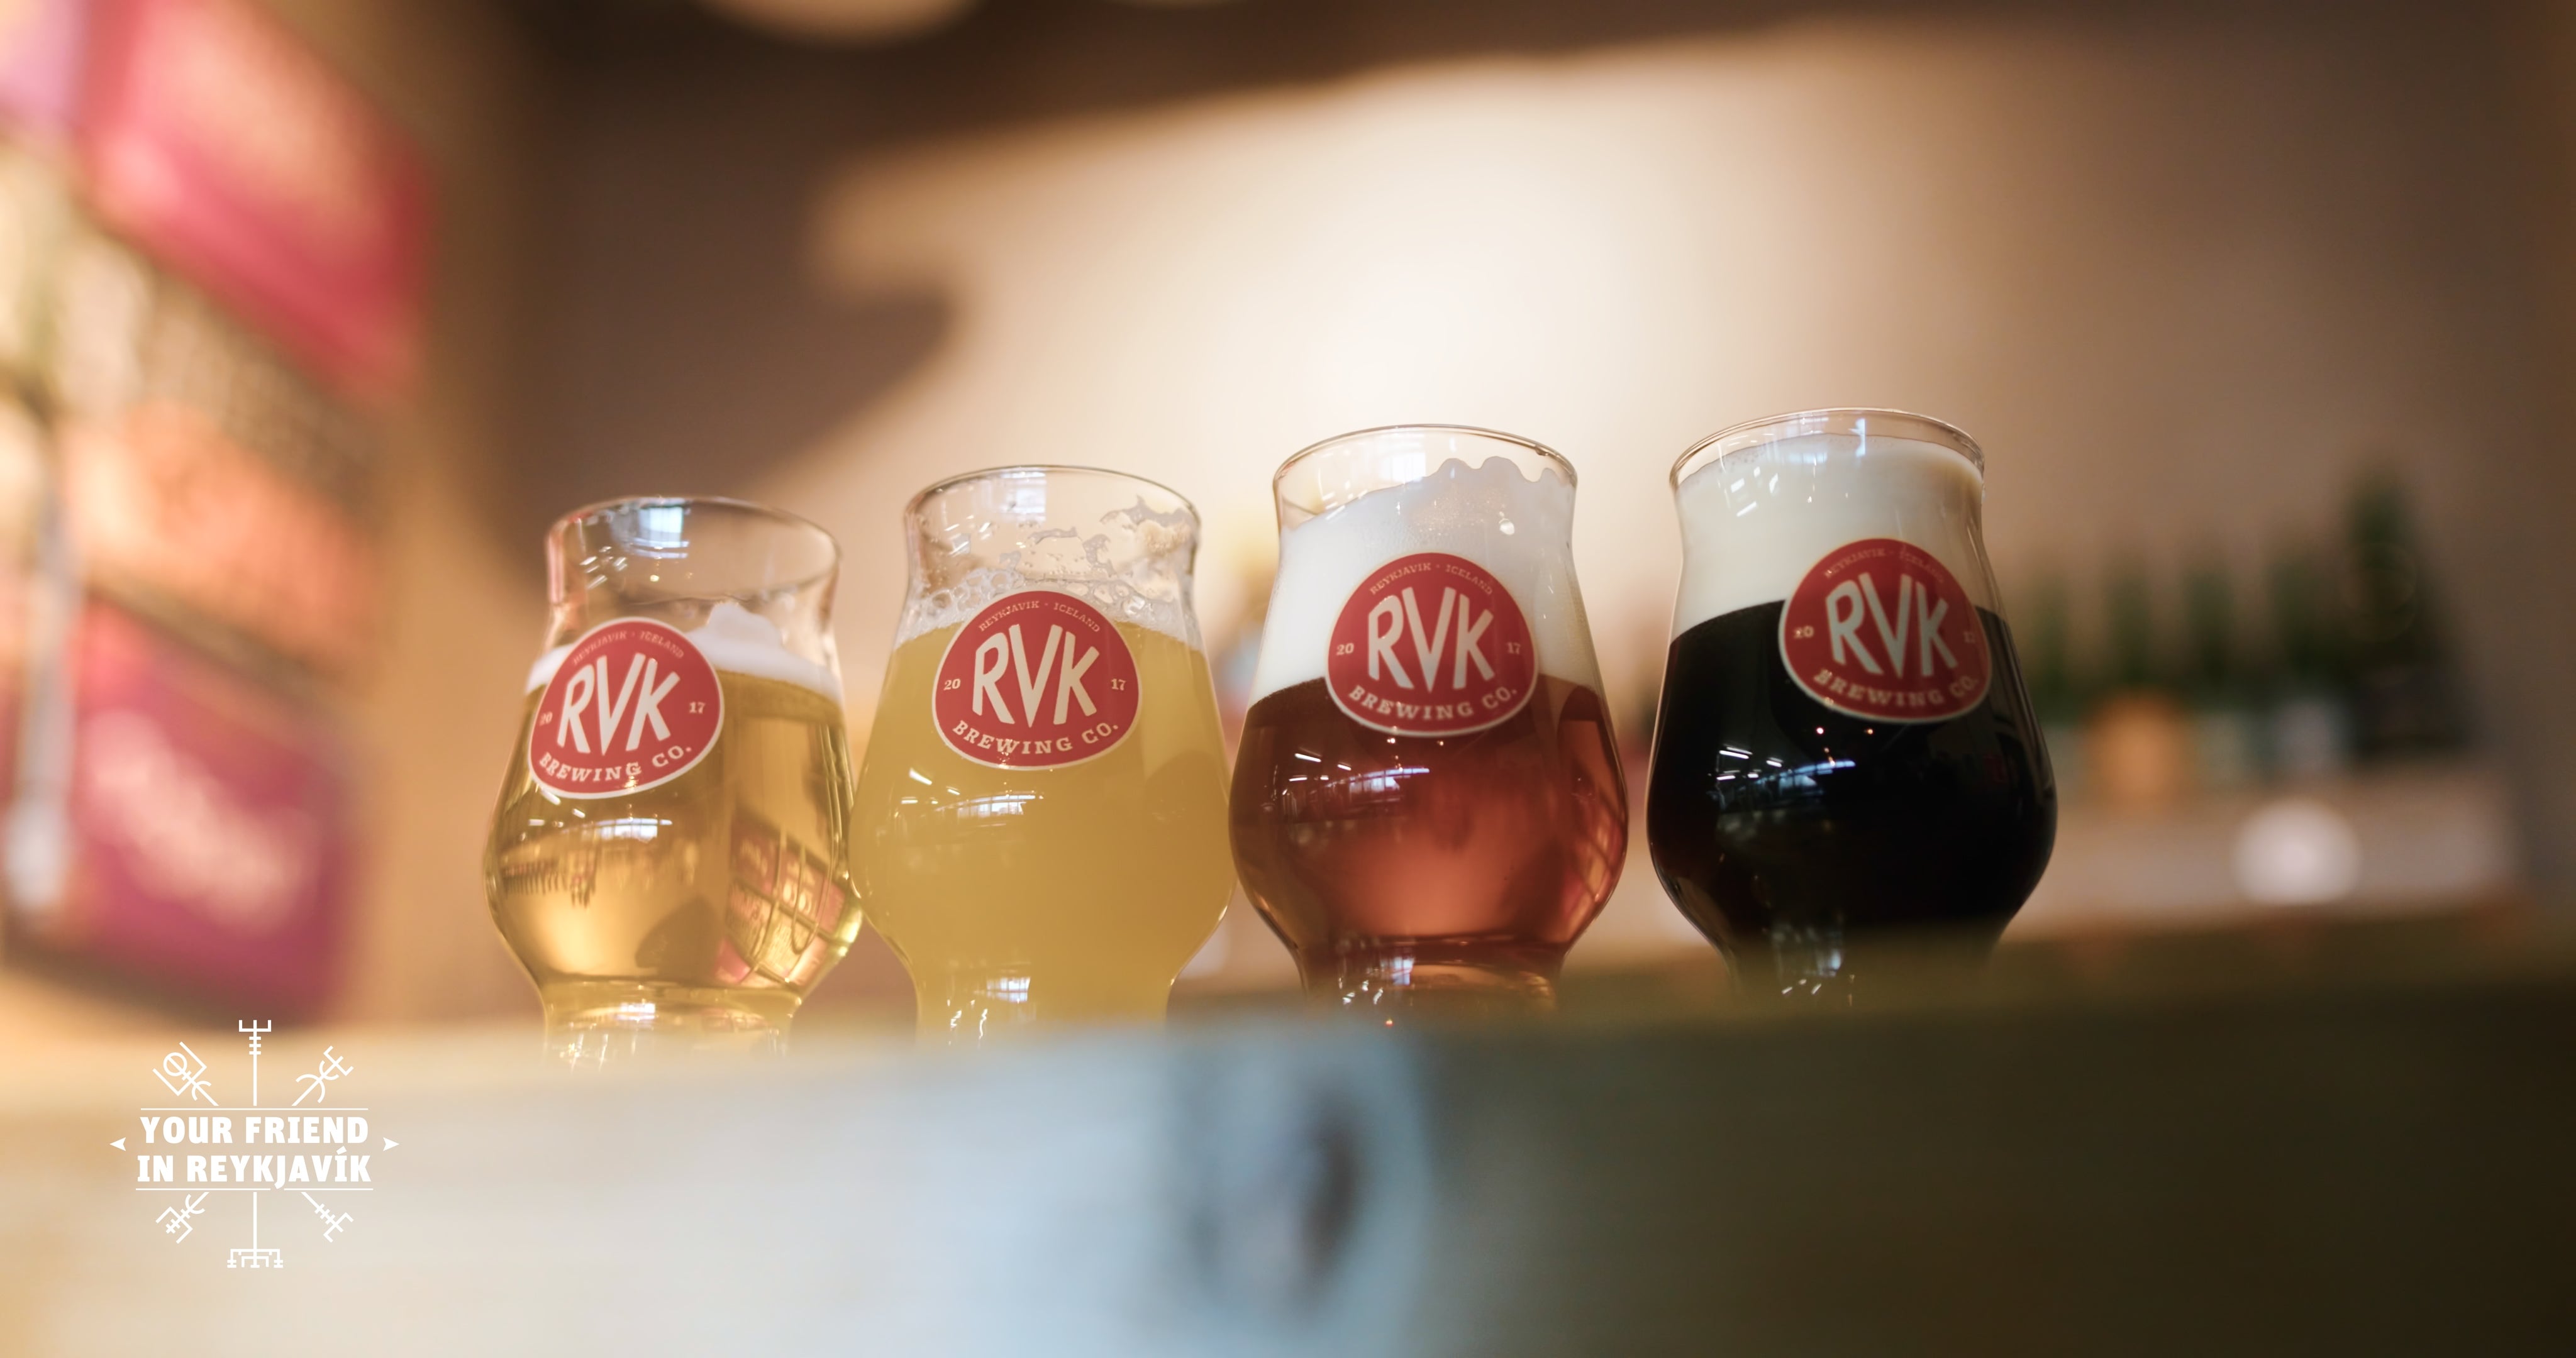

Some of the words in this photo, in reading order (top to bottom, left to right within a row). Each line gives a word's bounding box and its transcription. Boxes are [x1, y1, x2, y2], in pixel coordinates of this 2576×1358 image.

[1369, 563, 1431, 595] REYKJAVIK
[1446, 564, 1493, 596] ICELAND
[979, 601, 1040, 632] REYKJAVIK
[1053, 603, 1101, 632] ICELAND
[1826, 572, 1958, 679] RVK
[1336, 643, 1355, 656] 20
[1507, 643, 1521, 654] 17
[1368, 587, 1495, 693] RVK
[943, 678, 961, 691] 20
[1111, 678, 1126, 691] 17
[972, 624, 1100, 728] RVK
[557, 652, 680, 756] RVK
[689, 702, 706, 714] 17
[1349, 685, 1474, 720] BREWING
[1482, 687, 1518, 709] CO.
[952, 720, 1073, 754] BREWING
[1082, 722, 1119, 744] CO.
[539, 752, 641, 782] BREWING
[652, 745, 692, 767] CO.
